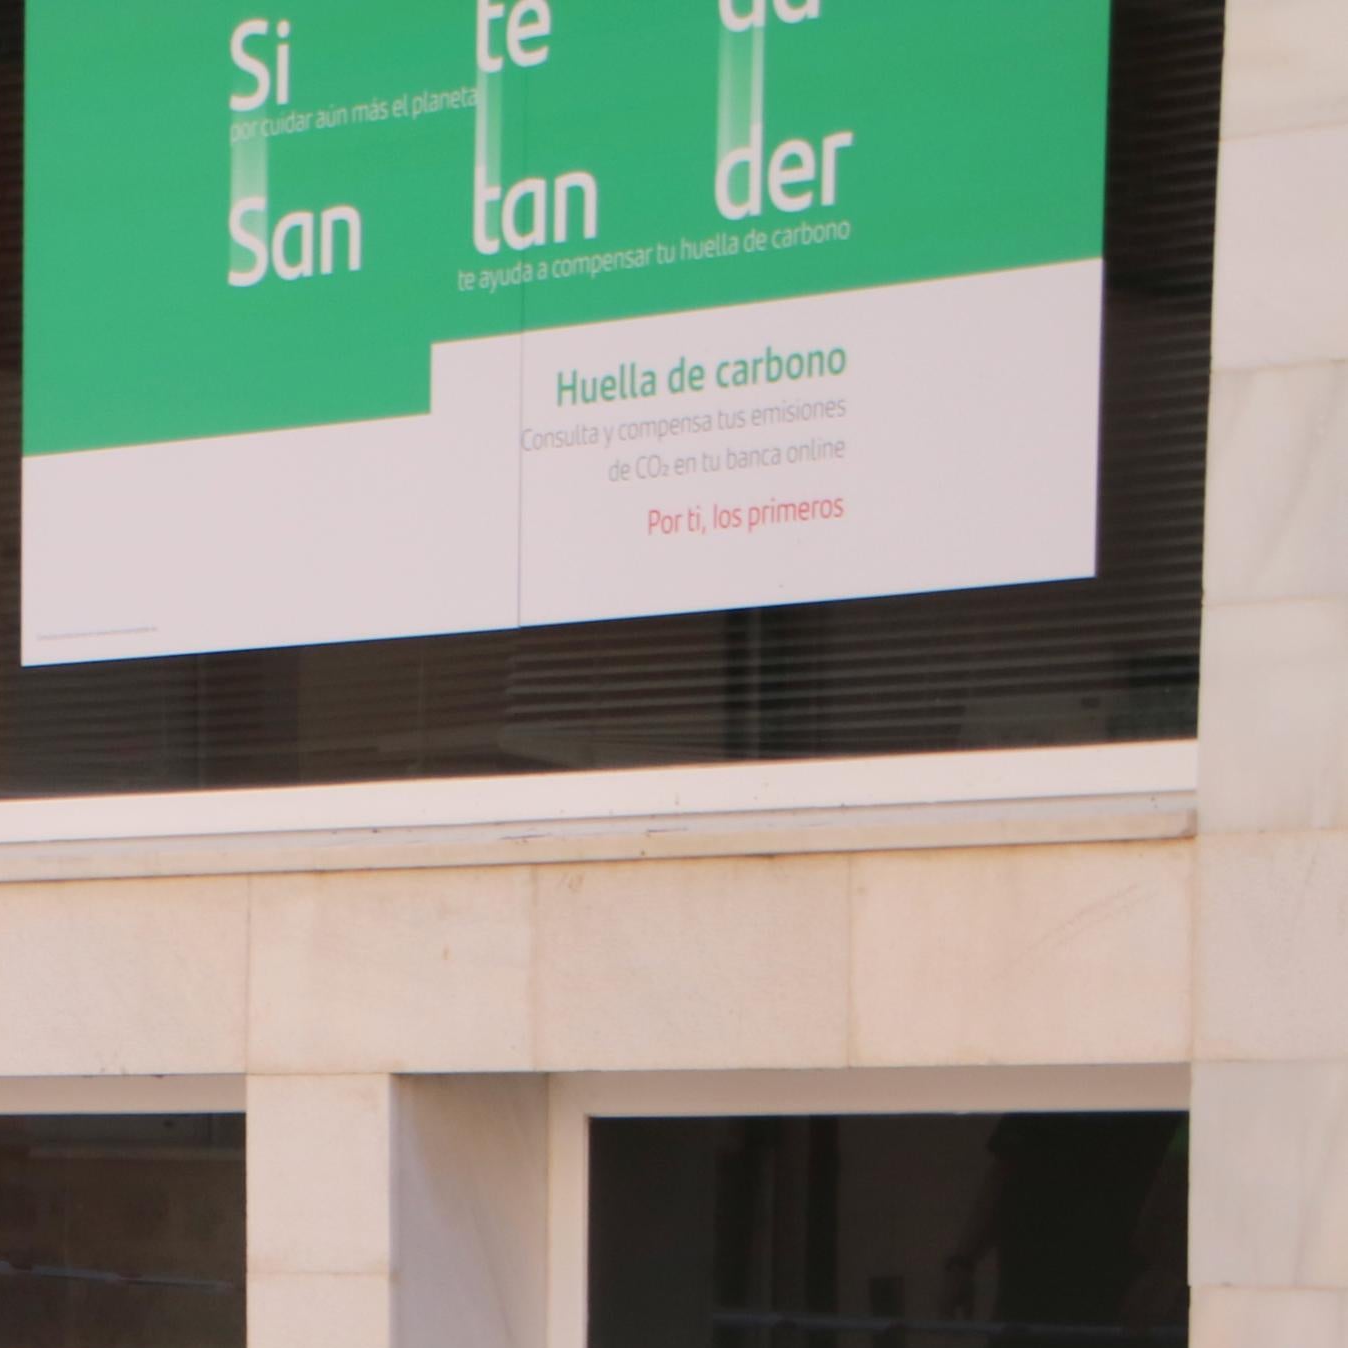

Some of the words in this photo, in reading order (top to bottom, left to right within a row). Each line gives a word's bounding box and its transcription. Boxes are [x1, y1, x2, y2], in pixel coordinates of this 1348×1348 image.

[229, 19, 291, 112] Si
[475, 0, 552, 73] te
[229, 121, 257, 143] por
[261, 111, 312, 138] cuidar
[315, 104, 348, 130] aún
[352, 97, 388, 123] más
[392, 94, 409, 117] el
[412, 85, 478, 120] planeta
[715, 123, 854, 221] der
[227, 195, 362, 287] San
[473, 163, 598, 255] tan
[457, 267, 475, 291] te
[479, 259, 533, 293] ayuda
[537, 264, 548, 281] a
[551, 246, 652, 282] compensar
[656, 243, 676, 264] tu
[680, 232, 739, 261] huella
[743, 228, 768, 253] de
[771, 219, 851, 249] carbono
[556, 365, 657, 407] Huella
[667, 356, 705, 394] de
[715, 345, 847, 388] carbono
[520, 424, 599, 452] Consulta
[603, 428, 614, 449] y
[617, 413, 713, 441] compensa
[717, 408, 746, 431] tus
[751, 398, 847, 427] emisiones
[608, 459, 631, 482] de
[674, 456, 697, 475] en
[701, 451, 721, 472] tu
[726, 447, 781, 470] banca
[786, 438, 846, 463] online
[647, 508, 683, 536] Por
[687, 505, 707, 535] ti,
[713, 503, 742, 530] los
[748, 496, 843, 533] primeros
